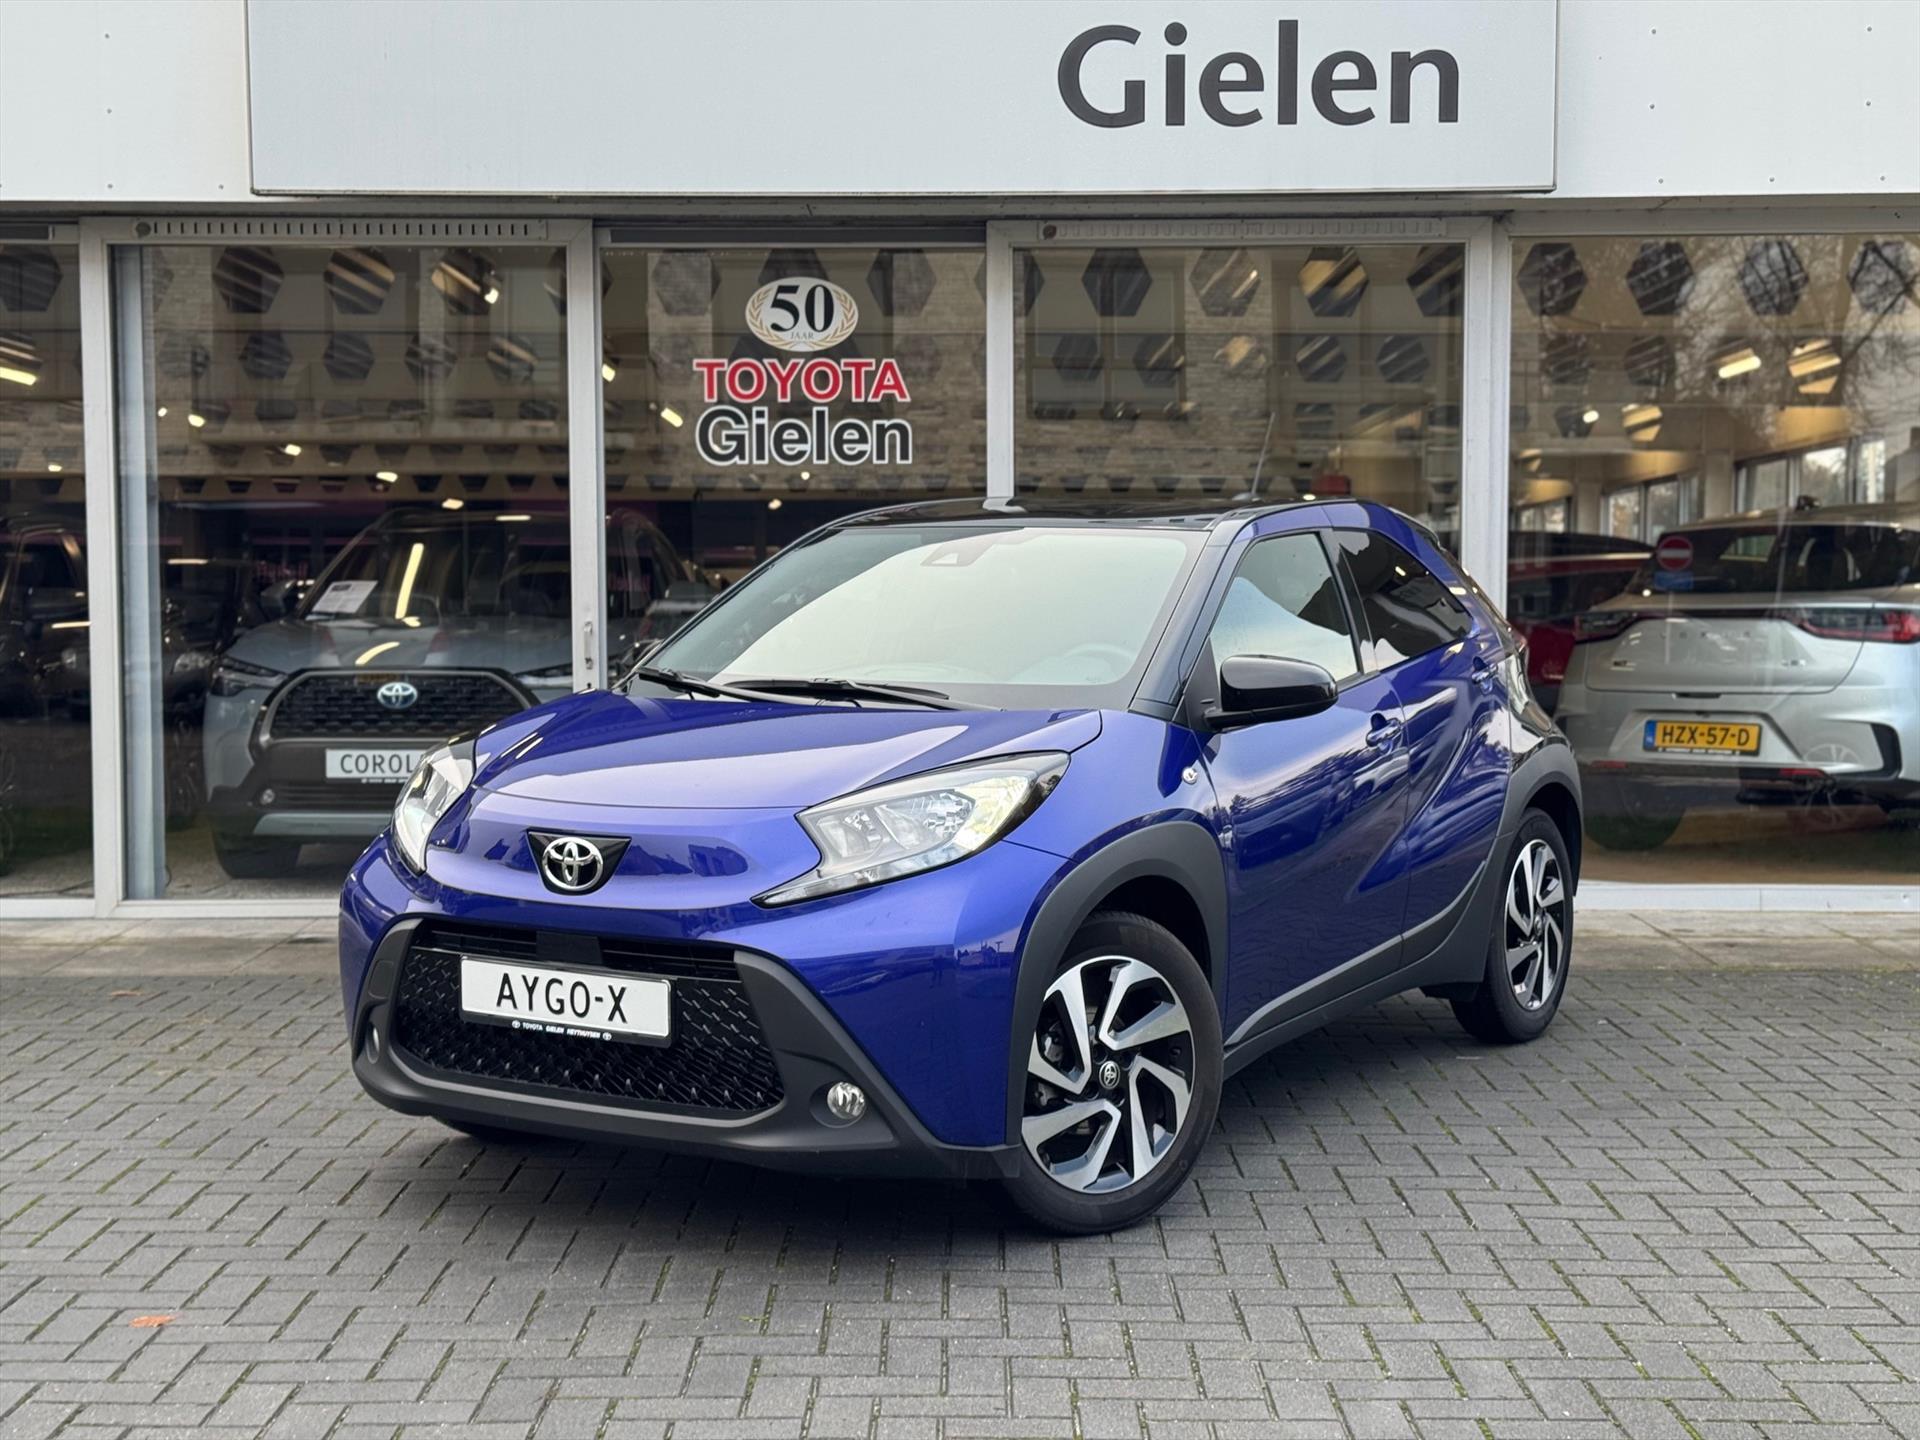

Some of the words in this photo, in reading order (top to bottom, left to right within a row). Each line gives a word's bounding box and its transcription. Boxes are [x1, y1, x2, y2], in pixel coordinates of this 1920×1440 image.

[1057, 19, 1460, 129] Gielen
[770, 284, 835, 332] 50
[791, 332, 814, 340] JAAR
[693, 358, 912, 403] TOYOTA
[695, 405, 913, 466] Gielen
[1661, 725, 1750, 747] HZX-57-D
[340, 753, 425, 774] COROL
[496, 972, 628, 1025] AYGO-X
[522, 1022, 543, 1031] TOYOTA
